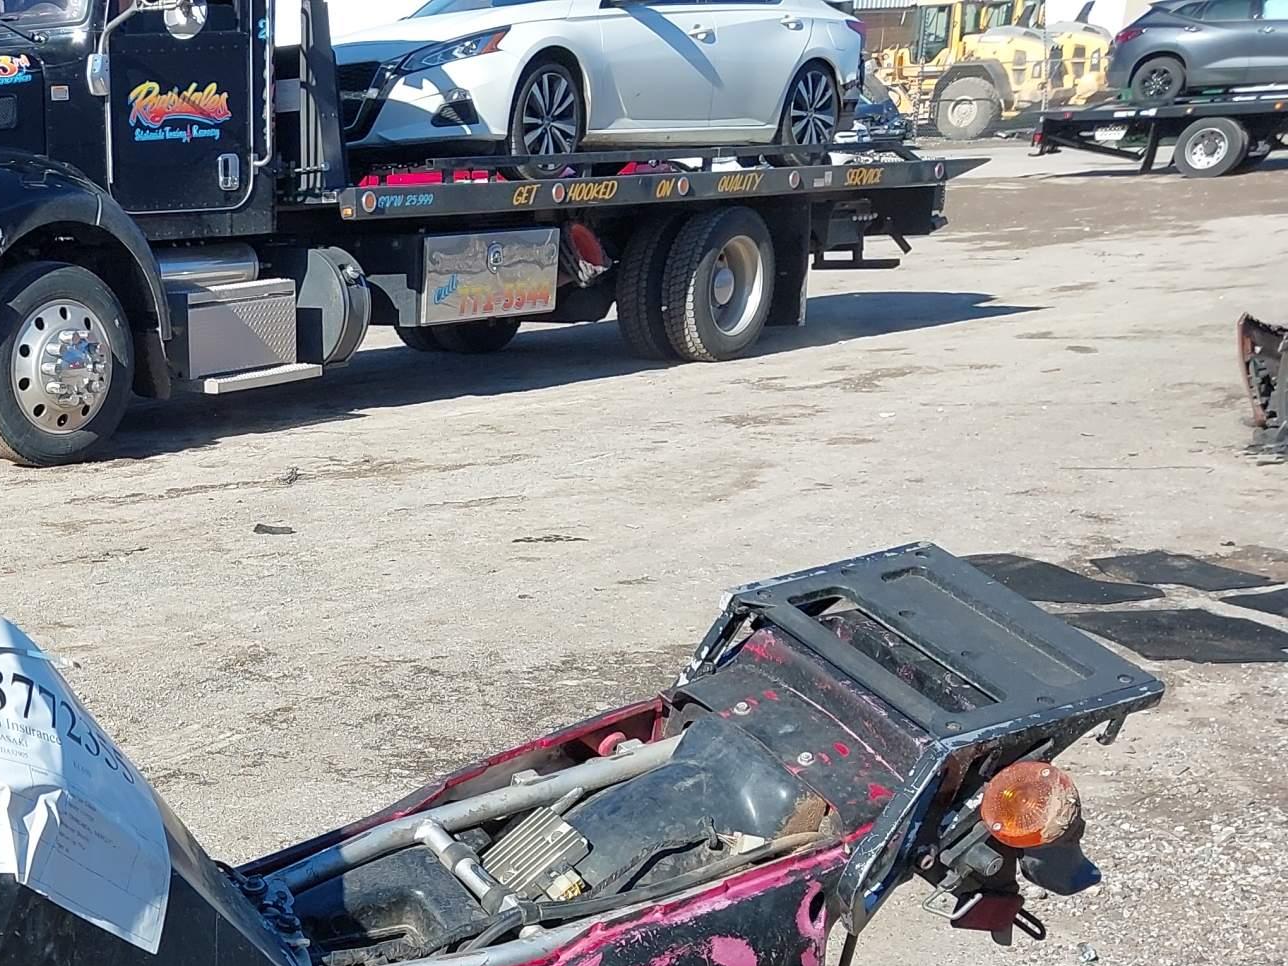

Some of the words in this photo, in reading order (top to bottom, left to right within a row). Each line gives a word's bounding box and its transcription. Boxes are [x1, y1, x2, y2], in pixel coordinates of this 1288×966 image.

[513, 184, 541, 205] GET
[566, 180, 618, 203] HOOKED
[656, 179, 674, 198] ON
[718, 172, 764, 193] QUALITY
[845, 167, 885, 186] SERVICE
[6, 718, 63, 746] Insurance
